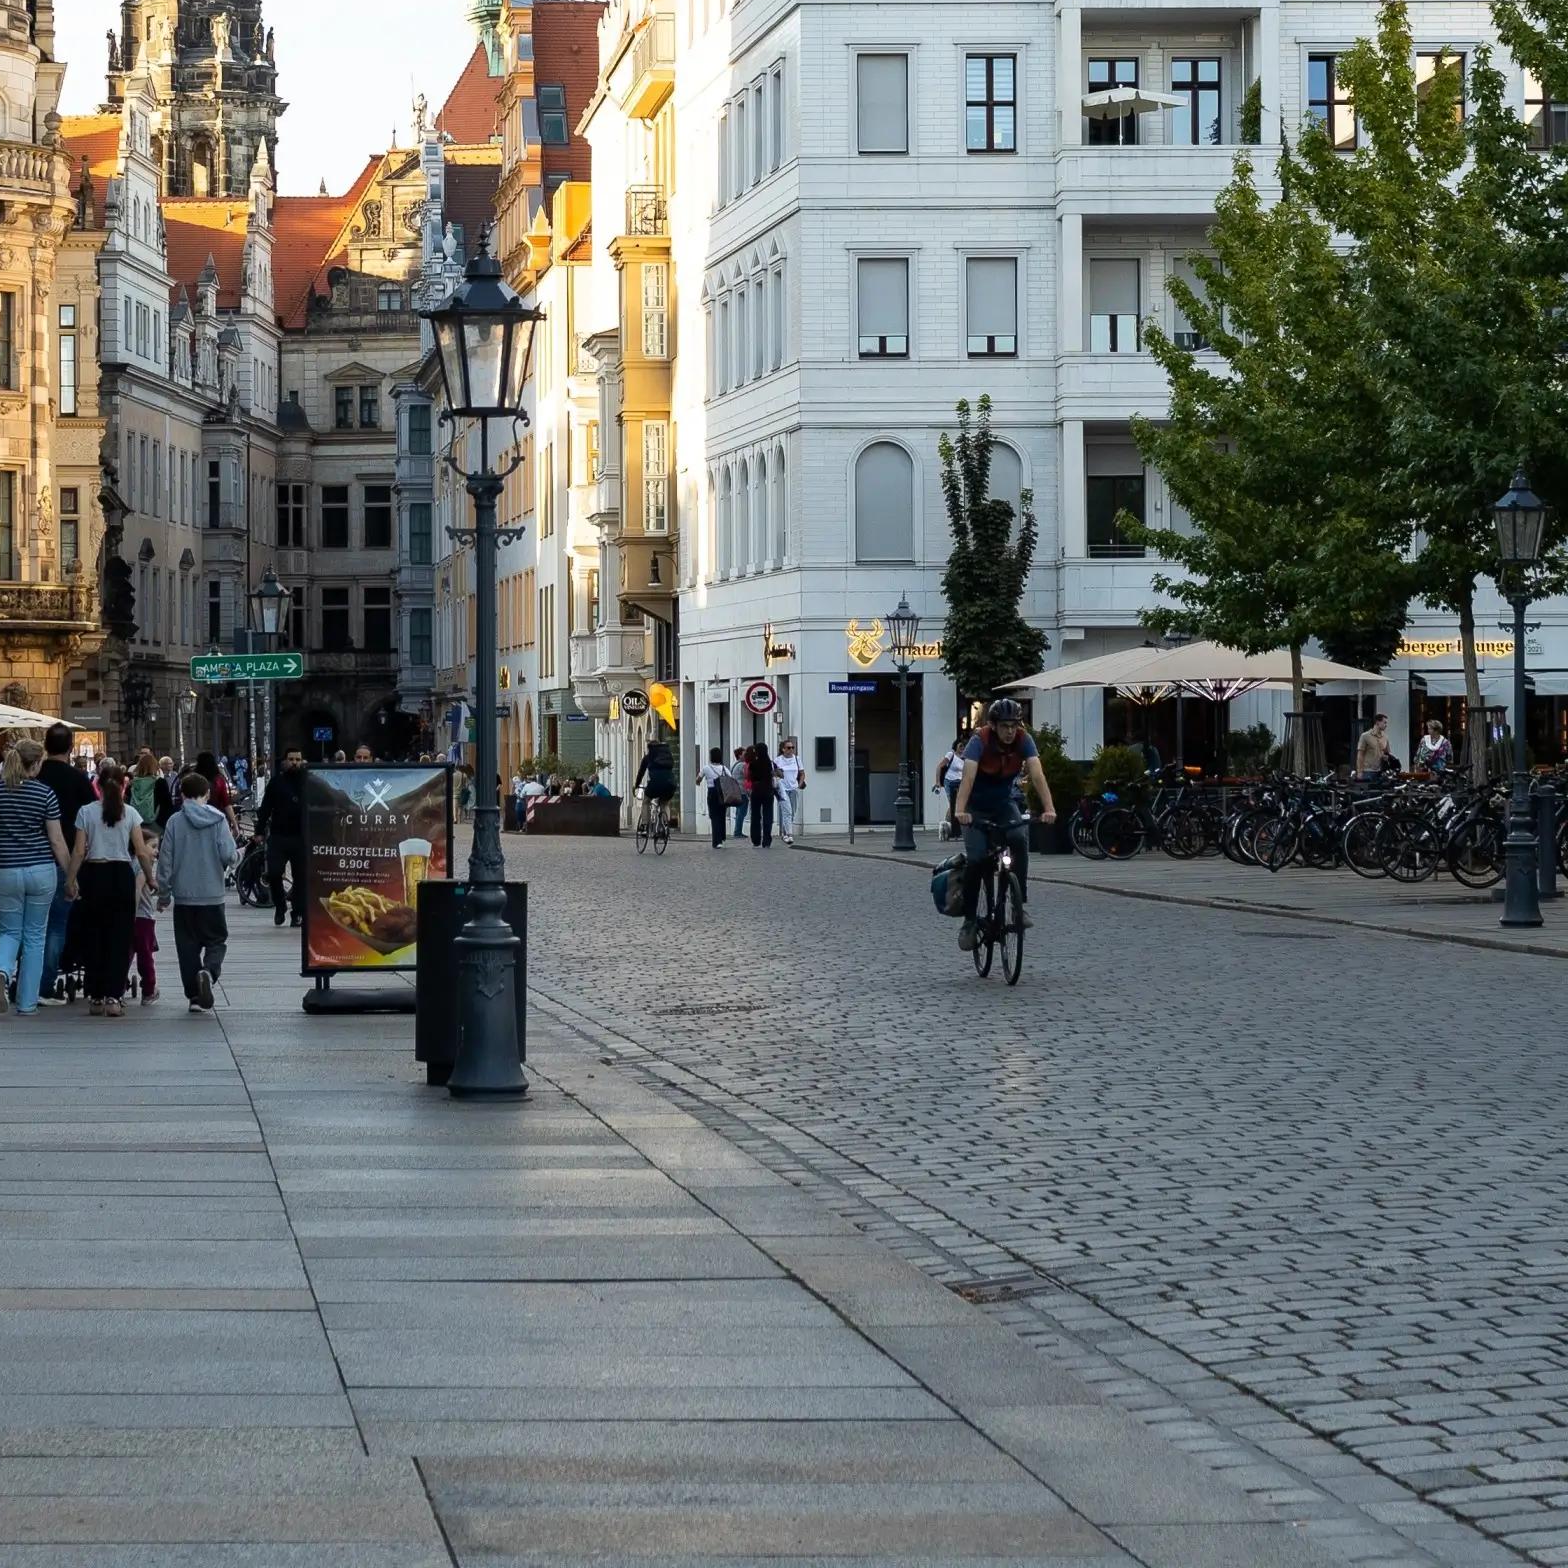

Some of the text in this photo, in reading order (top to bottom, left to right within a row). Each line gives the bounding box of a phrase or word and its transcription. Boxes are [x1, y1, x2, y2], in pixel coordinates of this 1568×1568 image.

[1456, 640, 1514, 655] Lunge
[246, 661, 280, 671] PLAZA
[346, 814, 410, 825] CURRY
[312, 845, 398, 858] SCHLOSSTELLER
[339, 859, 370, 870] 8,90€
